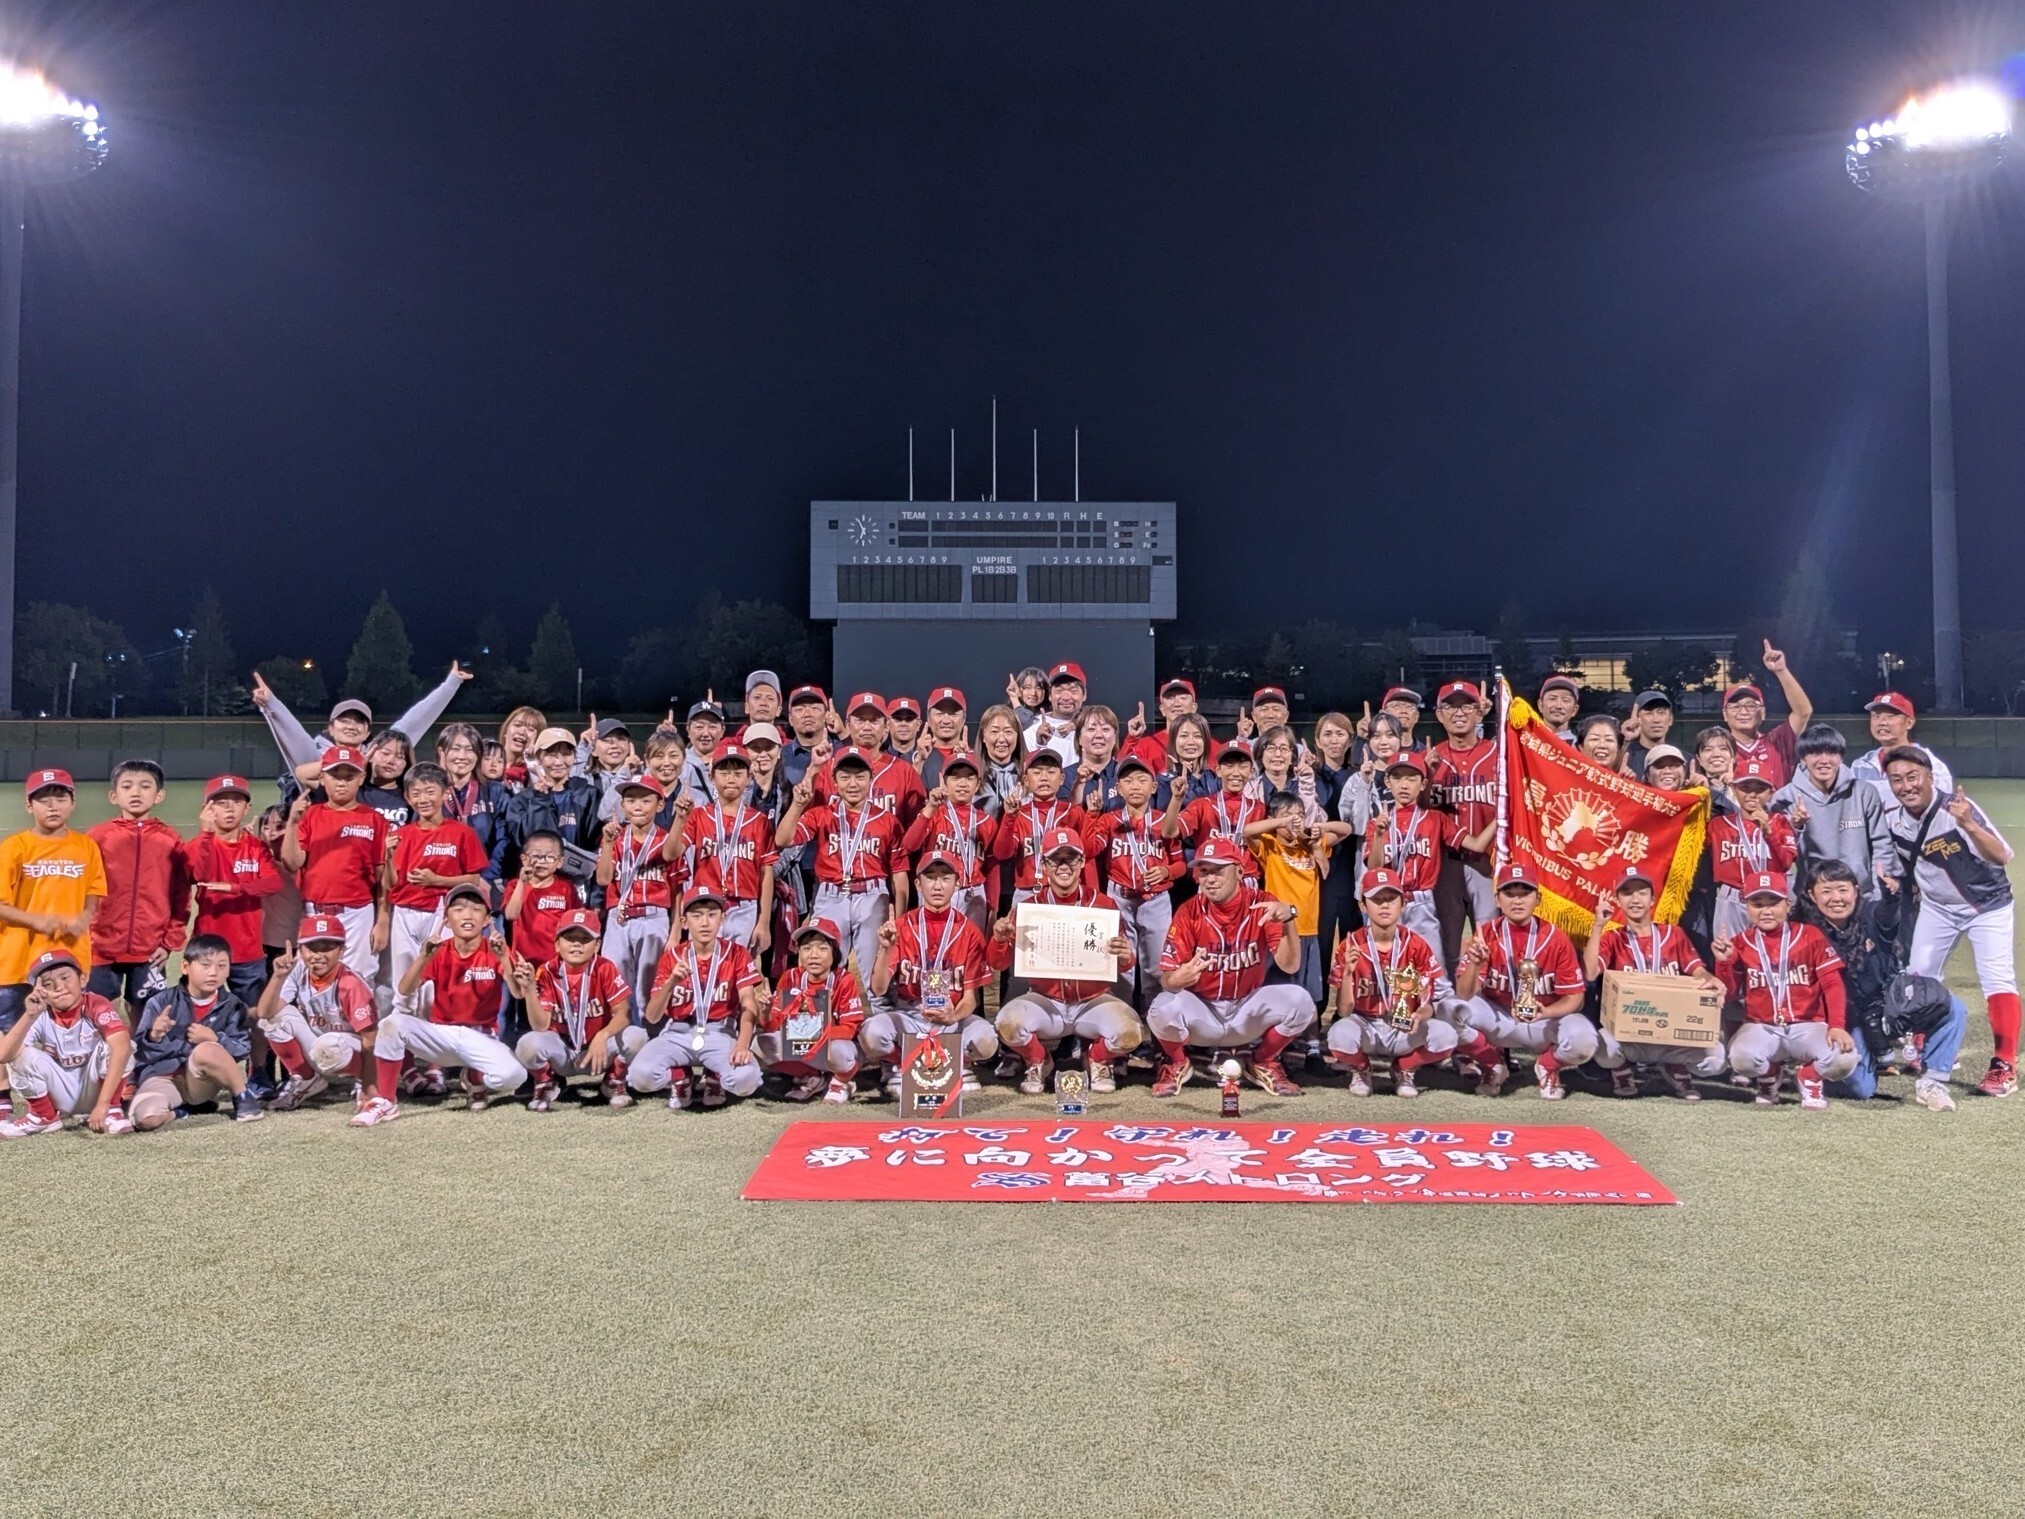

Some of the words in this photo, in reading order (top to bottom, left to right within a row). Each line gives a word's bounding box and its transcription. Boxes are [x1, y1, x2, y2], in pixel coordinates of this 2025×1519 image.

[902, 511, 926, 520] TEAM
[936, 511, 940, 520] 1
[948, 511, 953, 520] 2
[960, 511, 966, 520] 3
[972, 511, 979, 520] 4
[985, 511, 991, 520] 5
[997, 511, 1003, 520] 6
[1010, 511, 1016, 520] 7
[1022, 511, 1029, 520] 8
[1035, 511, 1041, 520] 9
[1047, 511, 1055, 520] 10
[1063, 511, 1070, 520] R
[1080, 511, 1087, 520] H
[1096, 511, 1103, 520] E
[852, 556, 857, 564] 1
[863, 556, 869, 564] 2
[875, 556, 880, 564] 3
[885, 556, 892, 564] 4
[897, 556, 903, 564] 5
[908, 556, 914, 564] 6
[919, 556, 925, 564] 7
[930, 556, 936, 564] 8
[941, 556, 948, 564] 9
[976, 556, 1013, 564] UMPIRE
[1042, 556, 1046, 564] 1
[1052, 556, 1058, 564] 2
[1064, 556, 1070, 564] 3
[1075, 556, 1081, 564] 4
[1086, 556, 1092, 564] 5
[1097, 556, 1103, 564] 6
[1108, 556, 1113, 564] 7
[1119, 556, 1125, 564] 8
[1130, 556, 1136, 564] 9
[972, 566, 984, 574] PL
[984, 566, 994, 574] 1B
[995, 566, 1006, 574] 2B
[1006, 566, 1017, 574] 3B
[340, 826, 375, 841] STRONG
[423, 844, 457, 858] STRONG
[1614, 829, 1650, 865] 勝
[30, 864, 80, 879] EAGLES
[1083, 922, 1098, 951] 優勝
[1686, 1015, 1705, 1025] 22g
[804, 1145, 1602, 1171] 夢に向かって全員野球
